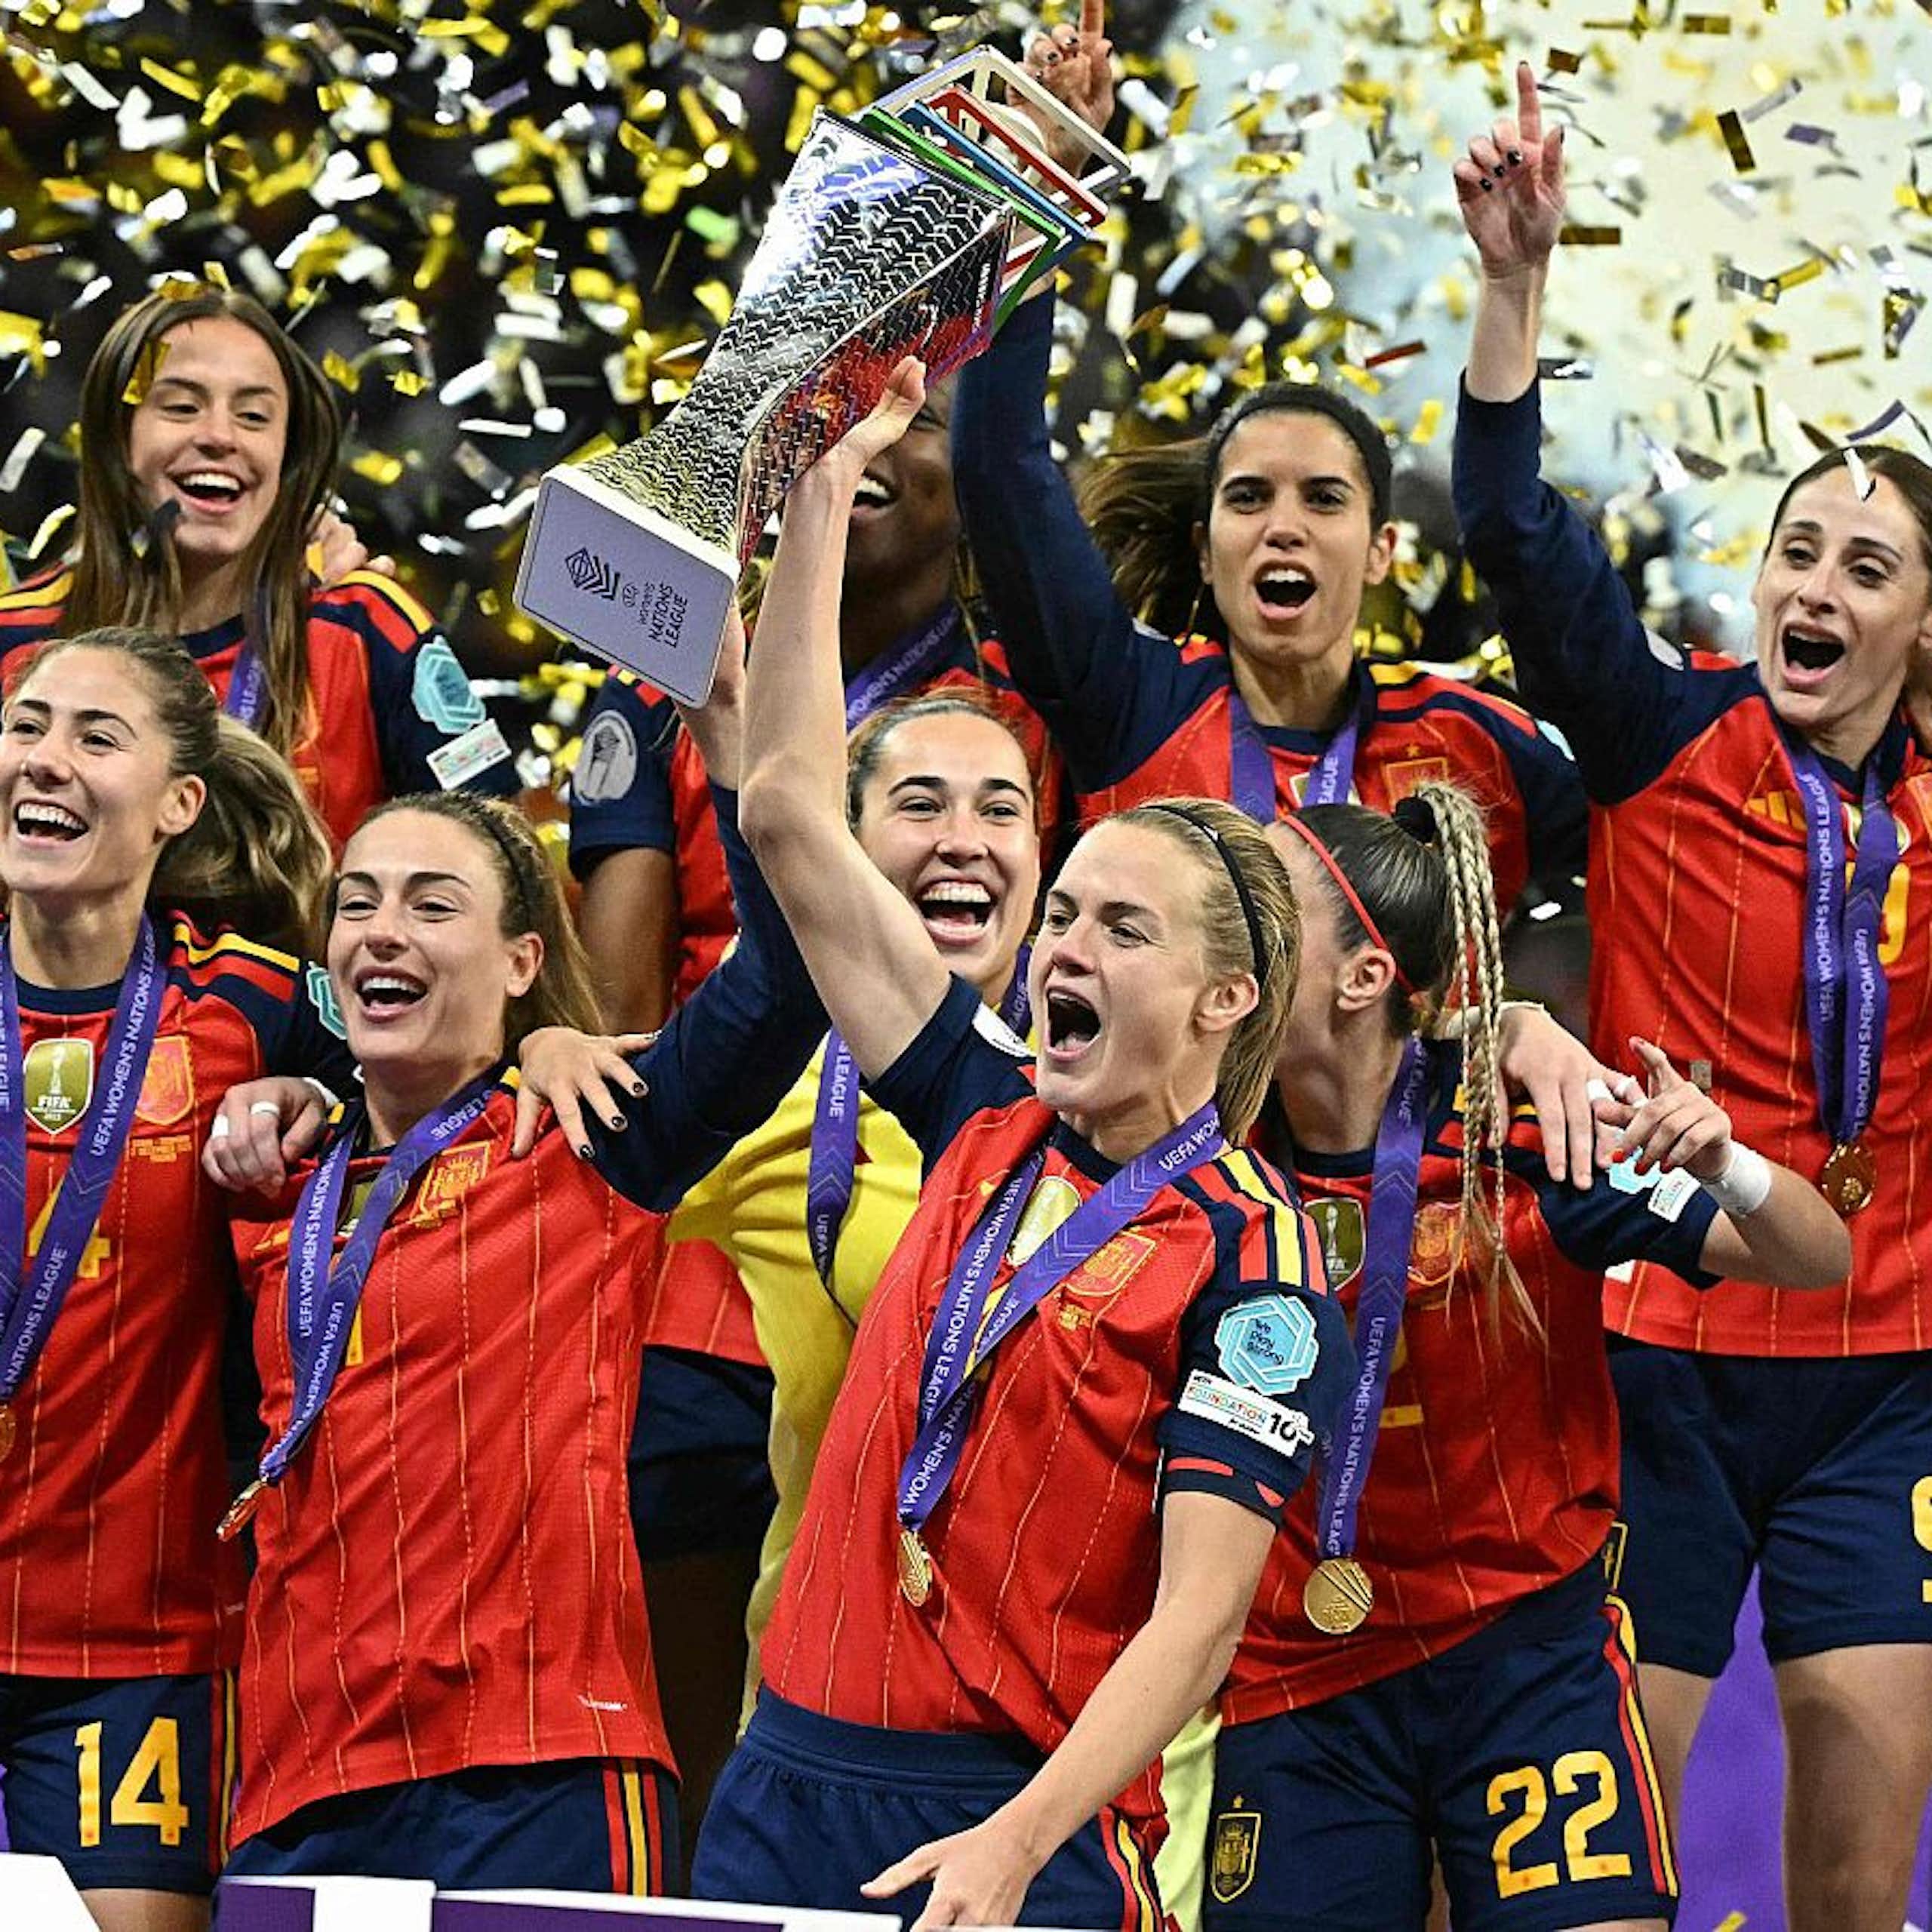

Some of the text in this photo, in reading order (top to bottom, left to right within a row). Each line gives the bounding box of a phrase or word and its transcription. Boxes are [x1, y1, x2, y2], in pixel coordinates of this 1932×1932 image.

[648, 583, 673, 642] NATIONS
[664, 595, 688, 648] LEAGUE
[1317, 756, 1338, 804] EAGUE
[1817, 829, 1833, 903] NATIONS
[1854, 928, 1872, 967] UEFA
[90, 1112, 114, 1156] UEFA
[125, 973, 152, 1041] NATIONS
[830, 1055, 851, 1118] LEAGUE
[431, 1098, 485, 1140] LEAGUE
[1158, 1141, 1197, 1171] UEFA
[1000, 1178, 1023, 1212] UEFA
[5, 1246, 67, 1385] NATIONS LEAGUE
[299, 1296, 312, 1337] UEFA
[323, 1302, 344, 1341] UEFA
[942, 1281, 975, 1353] NATIONS
[1366, 1317, 1386, 1357] UEFA
[1334, 1435, 1361, 1507] NATIONS
[75, 1716, 189, 1847] 14
[1486, 1750, 1632, 1899] 22
